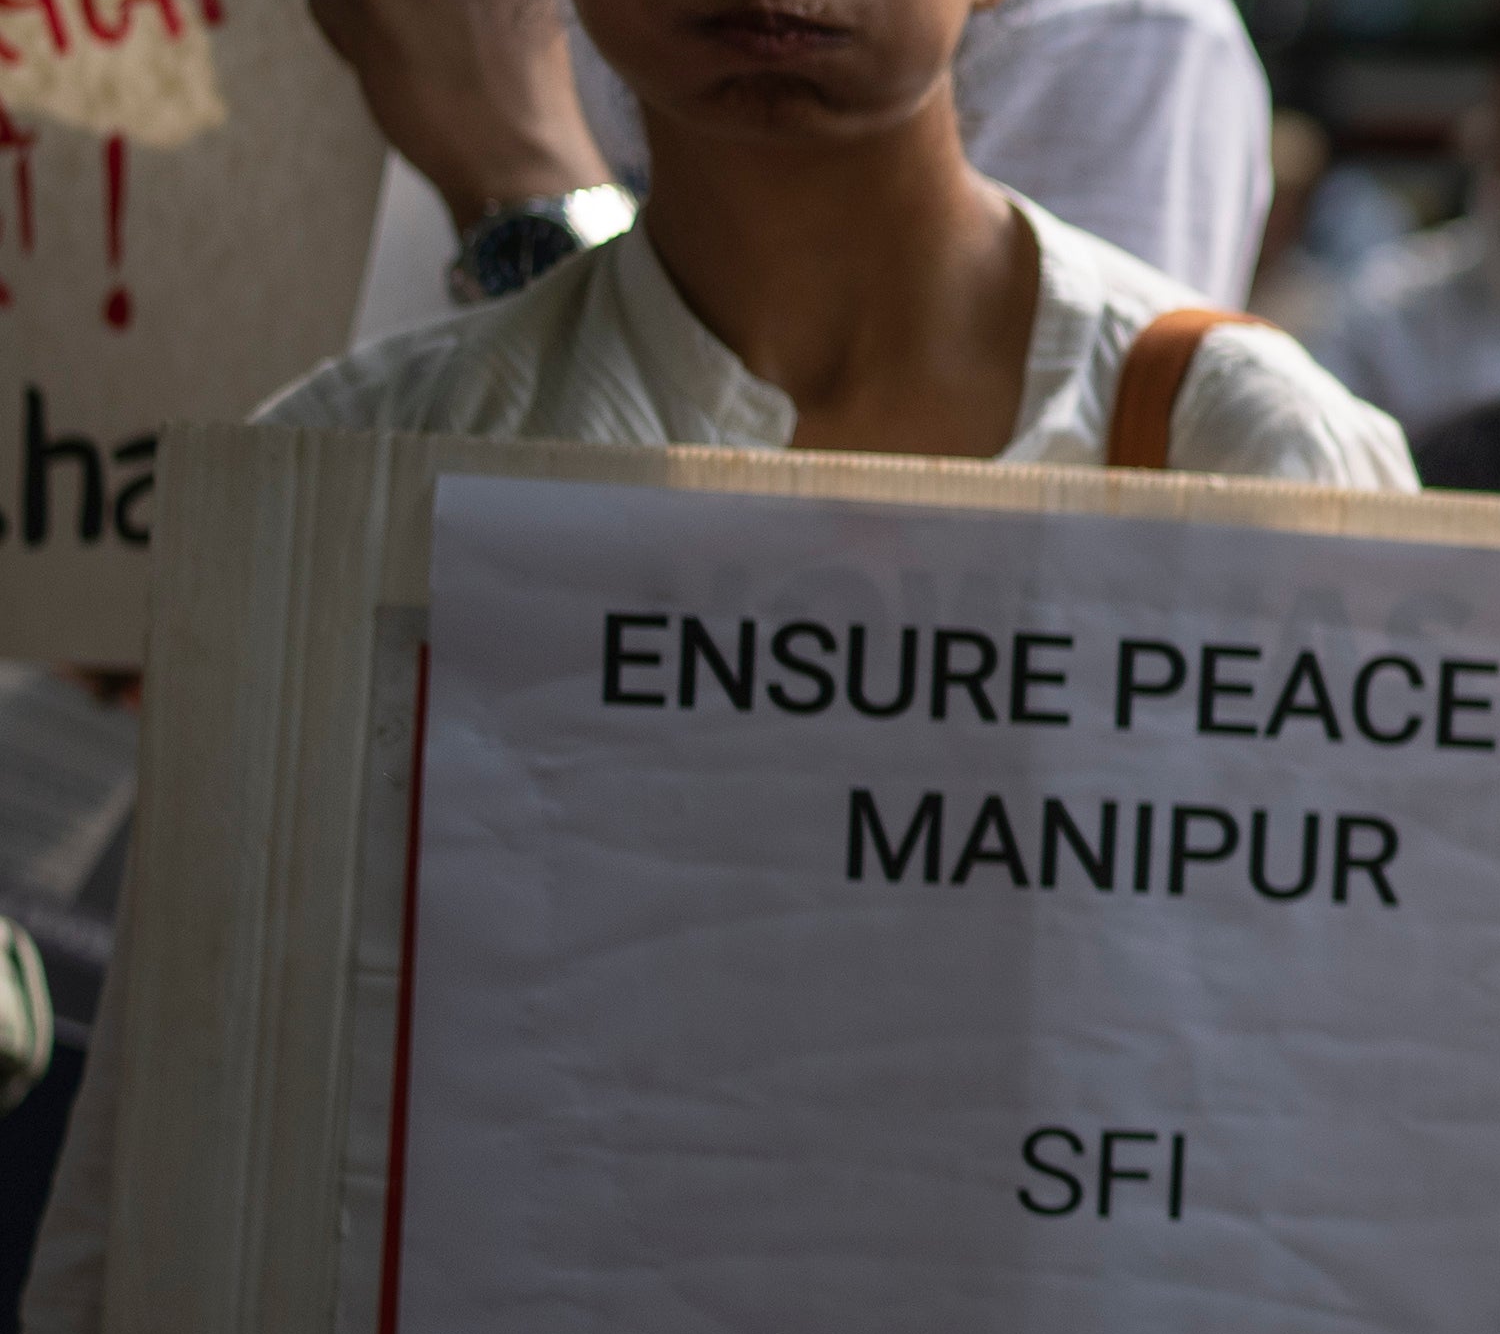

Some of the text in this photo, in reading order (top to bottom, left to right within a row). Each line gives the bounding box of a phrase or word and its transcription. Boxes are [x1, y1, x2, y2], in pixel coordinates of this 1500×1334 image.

[599, 610, 1076, 731] ENSURE
[1113, 636, 1499, 752] PEACE
[843, 787, 1403, 910] MANIPUR
[1013, 1124, 1191, 1224] SFI
